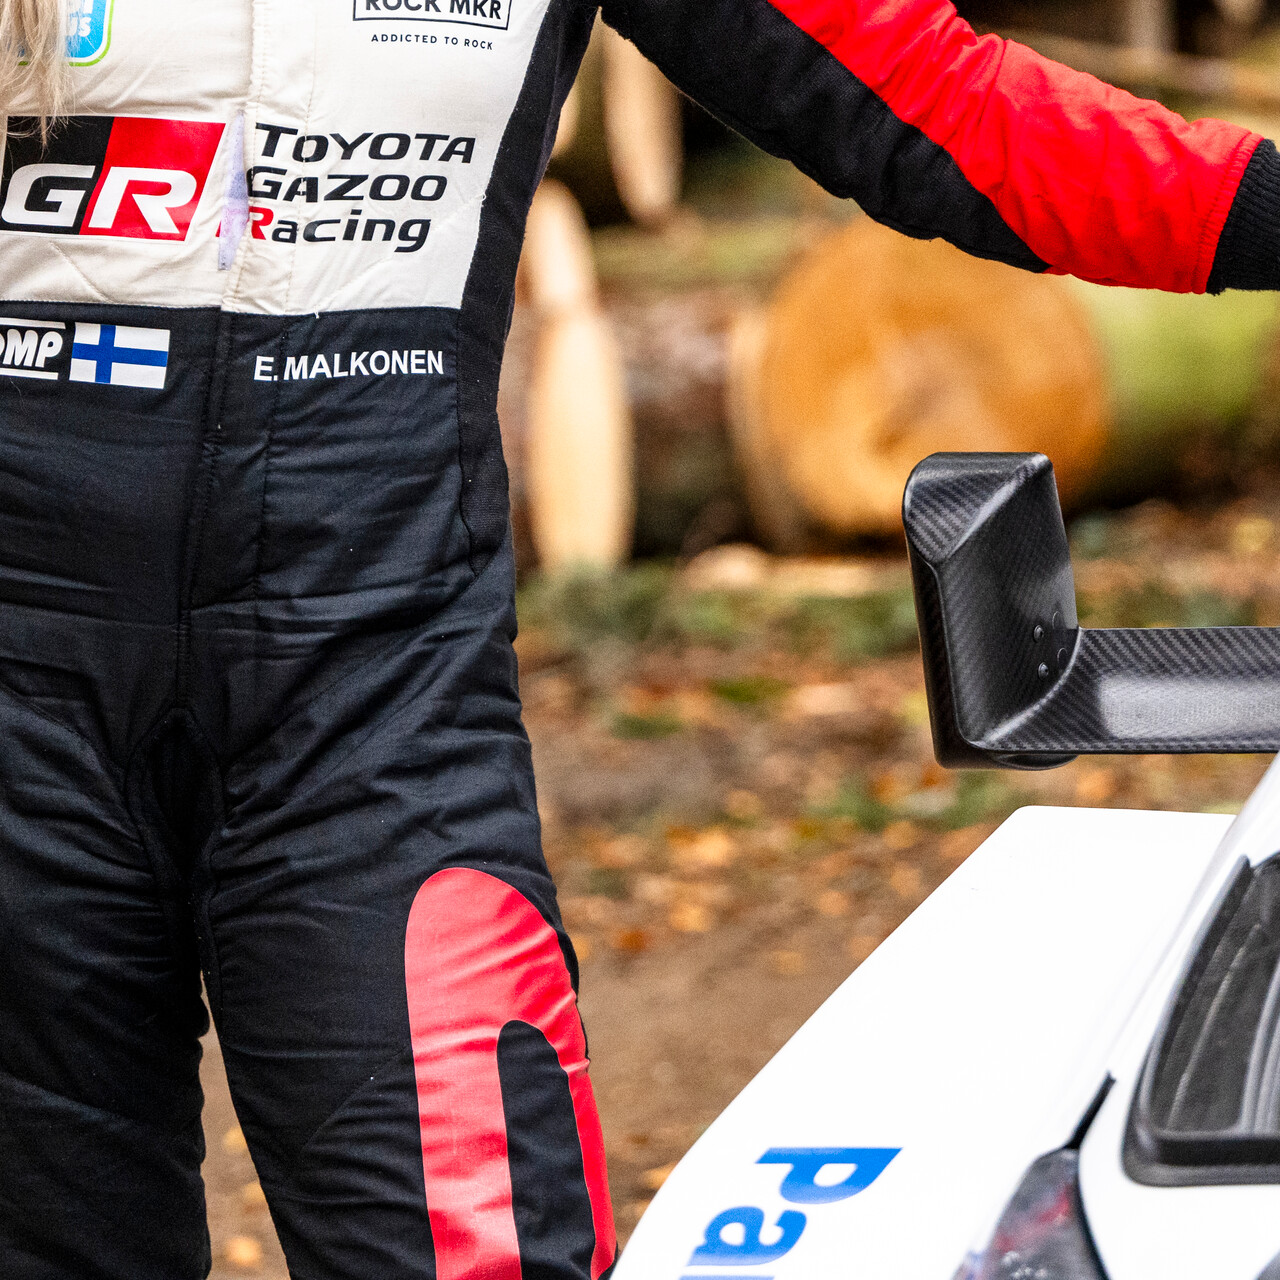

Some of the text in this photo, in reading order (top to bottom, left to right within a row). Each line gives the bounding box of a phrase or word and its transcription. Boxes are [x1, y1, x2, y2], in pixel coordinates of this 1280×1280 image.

[371, 34, 494, 51] ADDICTED TO ROCK
[255, 122, 476, 164] TOYOTA
[1, 163, 198, 234] GR
[246, 165, 448, 203] GAZOO
[215, 206, 431, 253] Racing
[284, 350, 444, 380] MALKONEN
[678, 1147, 904, 1280] Pa
